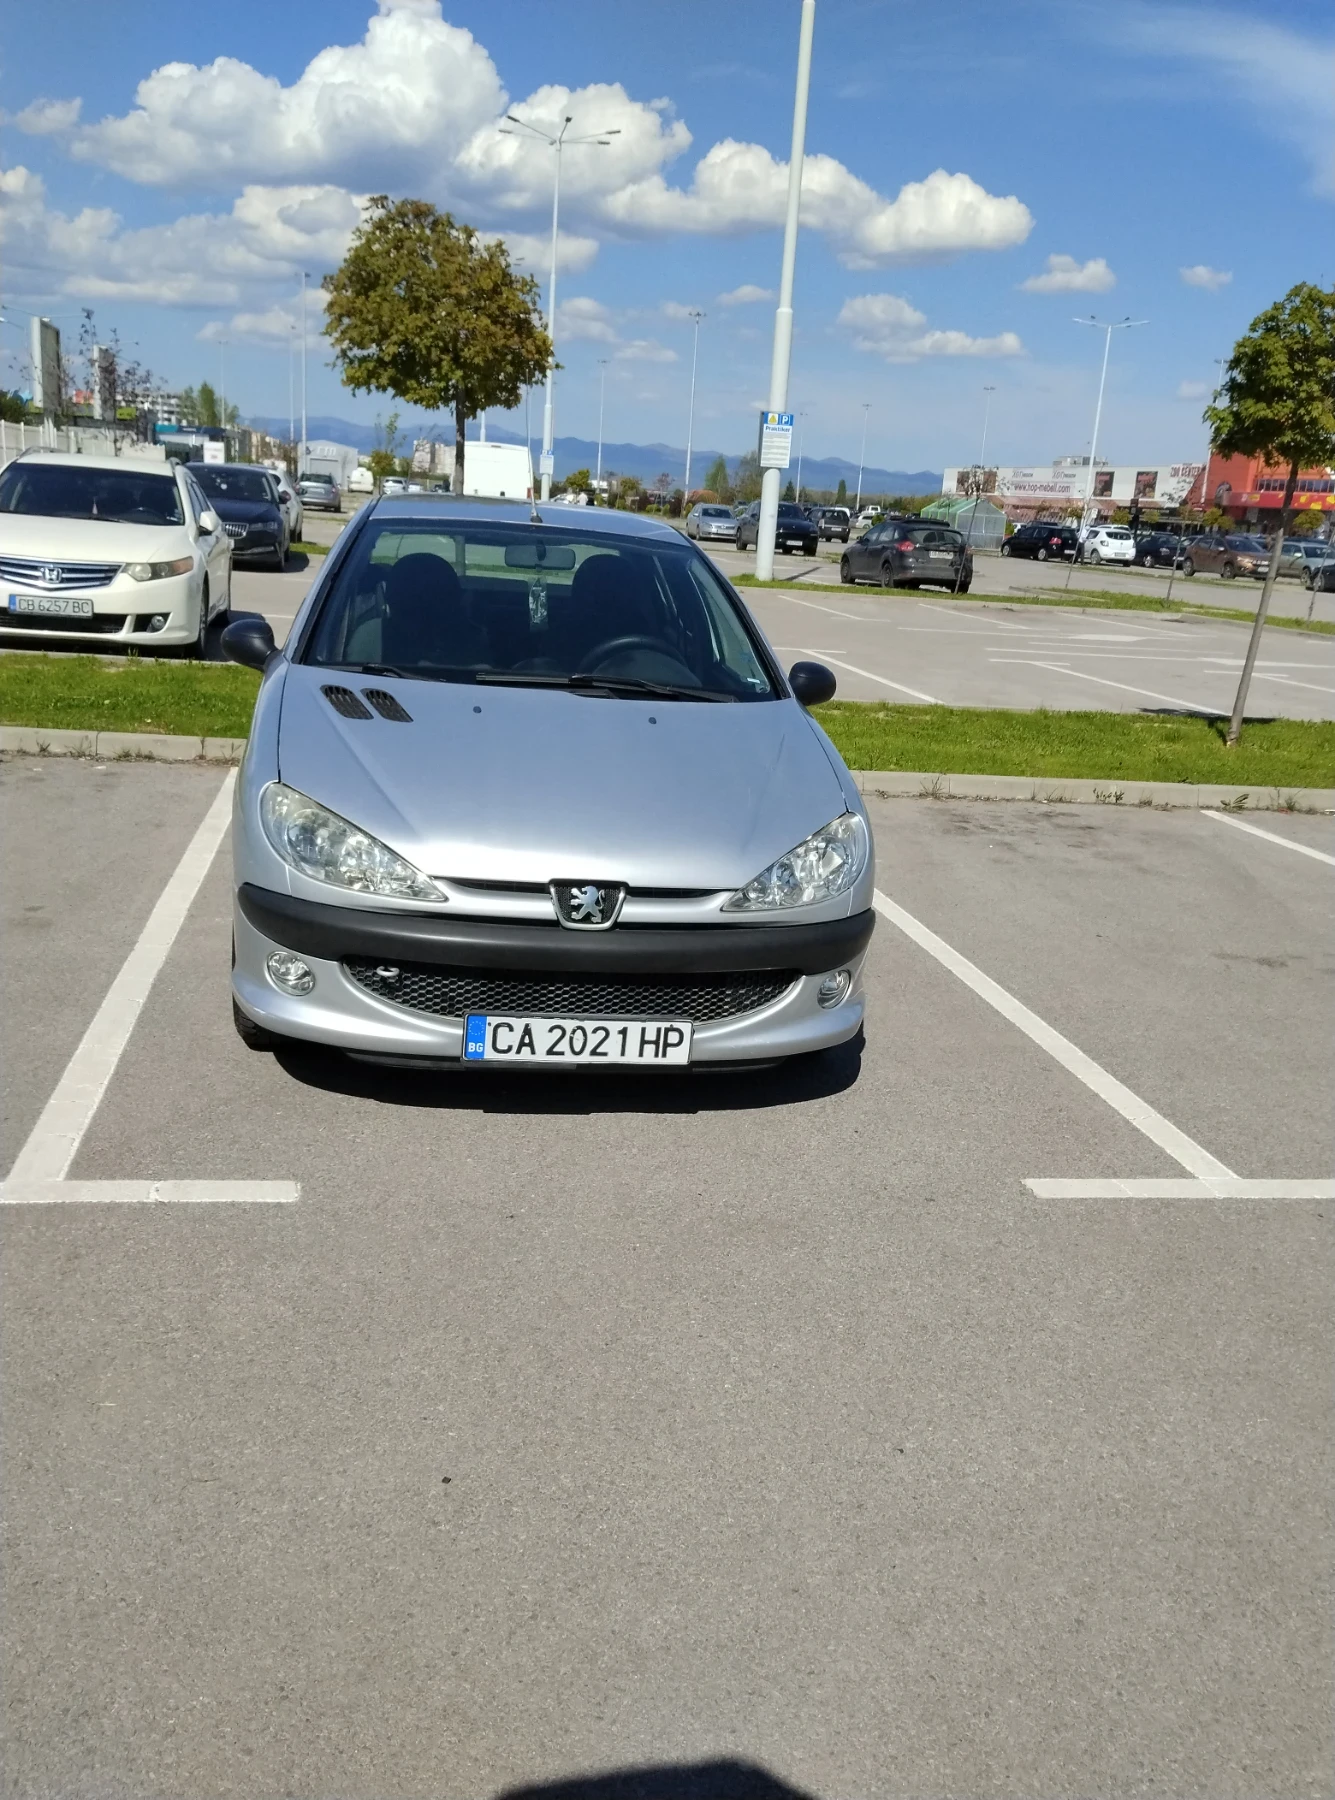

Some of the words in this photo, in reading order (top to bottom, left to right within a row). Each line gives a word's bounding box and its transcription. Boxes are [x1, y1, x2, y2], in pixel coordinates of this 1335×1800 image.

[782, 416, 789, 424] P
[18, 598, 35, 611] CB
[38, 600, 69, 613] 6257
[72, 601, 90, 614] BC
[491, 1022, 536, 1055] CA
[546, 1025, 629, 1057] 2021
[638, 1027, 685, 1058] HP
[468, 1042, 484, 1053] BG
